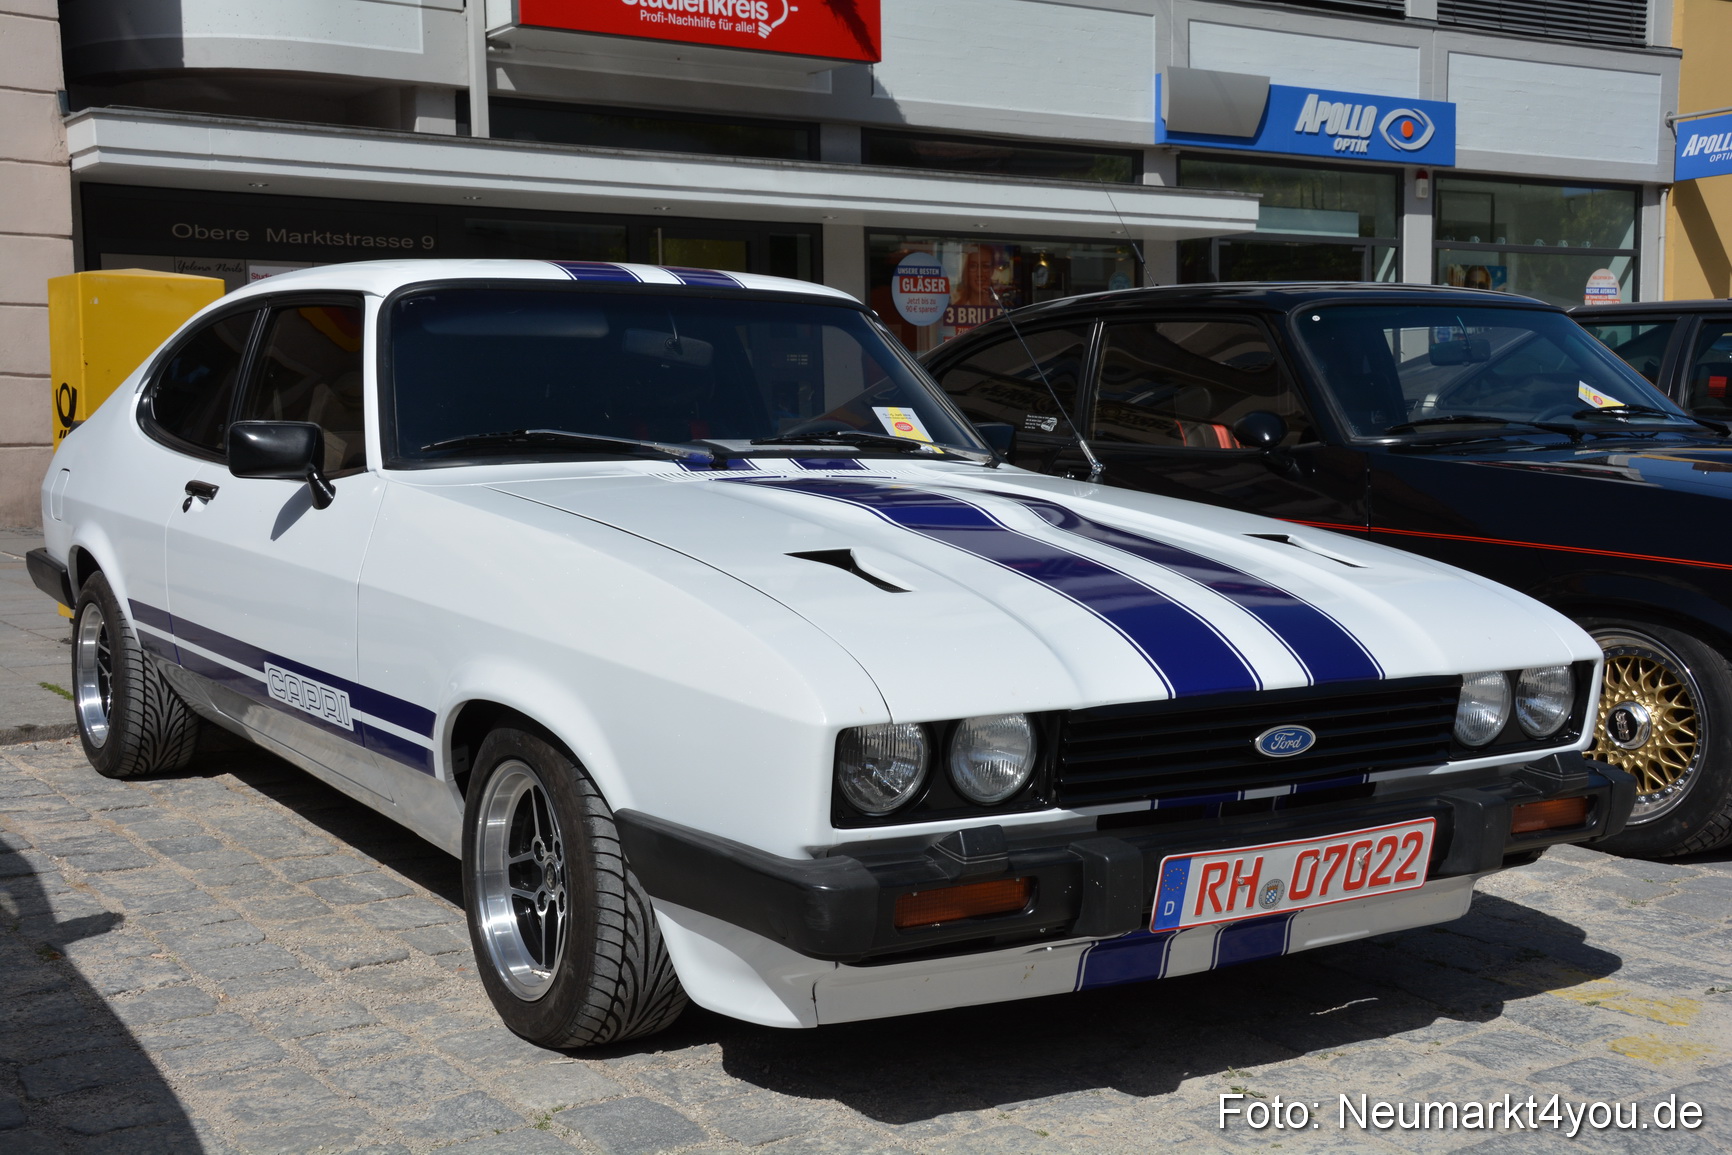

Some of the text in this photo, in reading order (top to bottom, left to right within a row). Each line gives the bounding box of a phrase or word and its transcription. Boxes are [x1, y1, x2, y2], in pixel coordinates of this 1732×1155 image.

[640, 9, 756, 33] Profi-Nachhilfe für alle!
[1294, 93, 1378, 138] APOLLO
[1333, 137, 1370, 153] OPTIK
[1681, 132, 1732, 157] APOLL
[171, 223, 435, 250] Obere Marktstrasse 9
[215, 262, 244, 274] Nails
[897, 267, 940, 275] UNSERE BESTEN
[902, 275, 946, 293] GLÄSER
[906, 297, 921, 305] Jetzt
[921, 297, 929, 305] bis
[918, 305, 938, 314] sparen!
[945, 307, 1014, 324] 3 BRILL
[268, 667, 350, 727] CAPRI
[1270, 732, 1303, 751] Ford
[1193, 856, 1264, 917] RH
[1287, 830, 1425, 901] 07022
[1163, 900, 1176, 916] D
